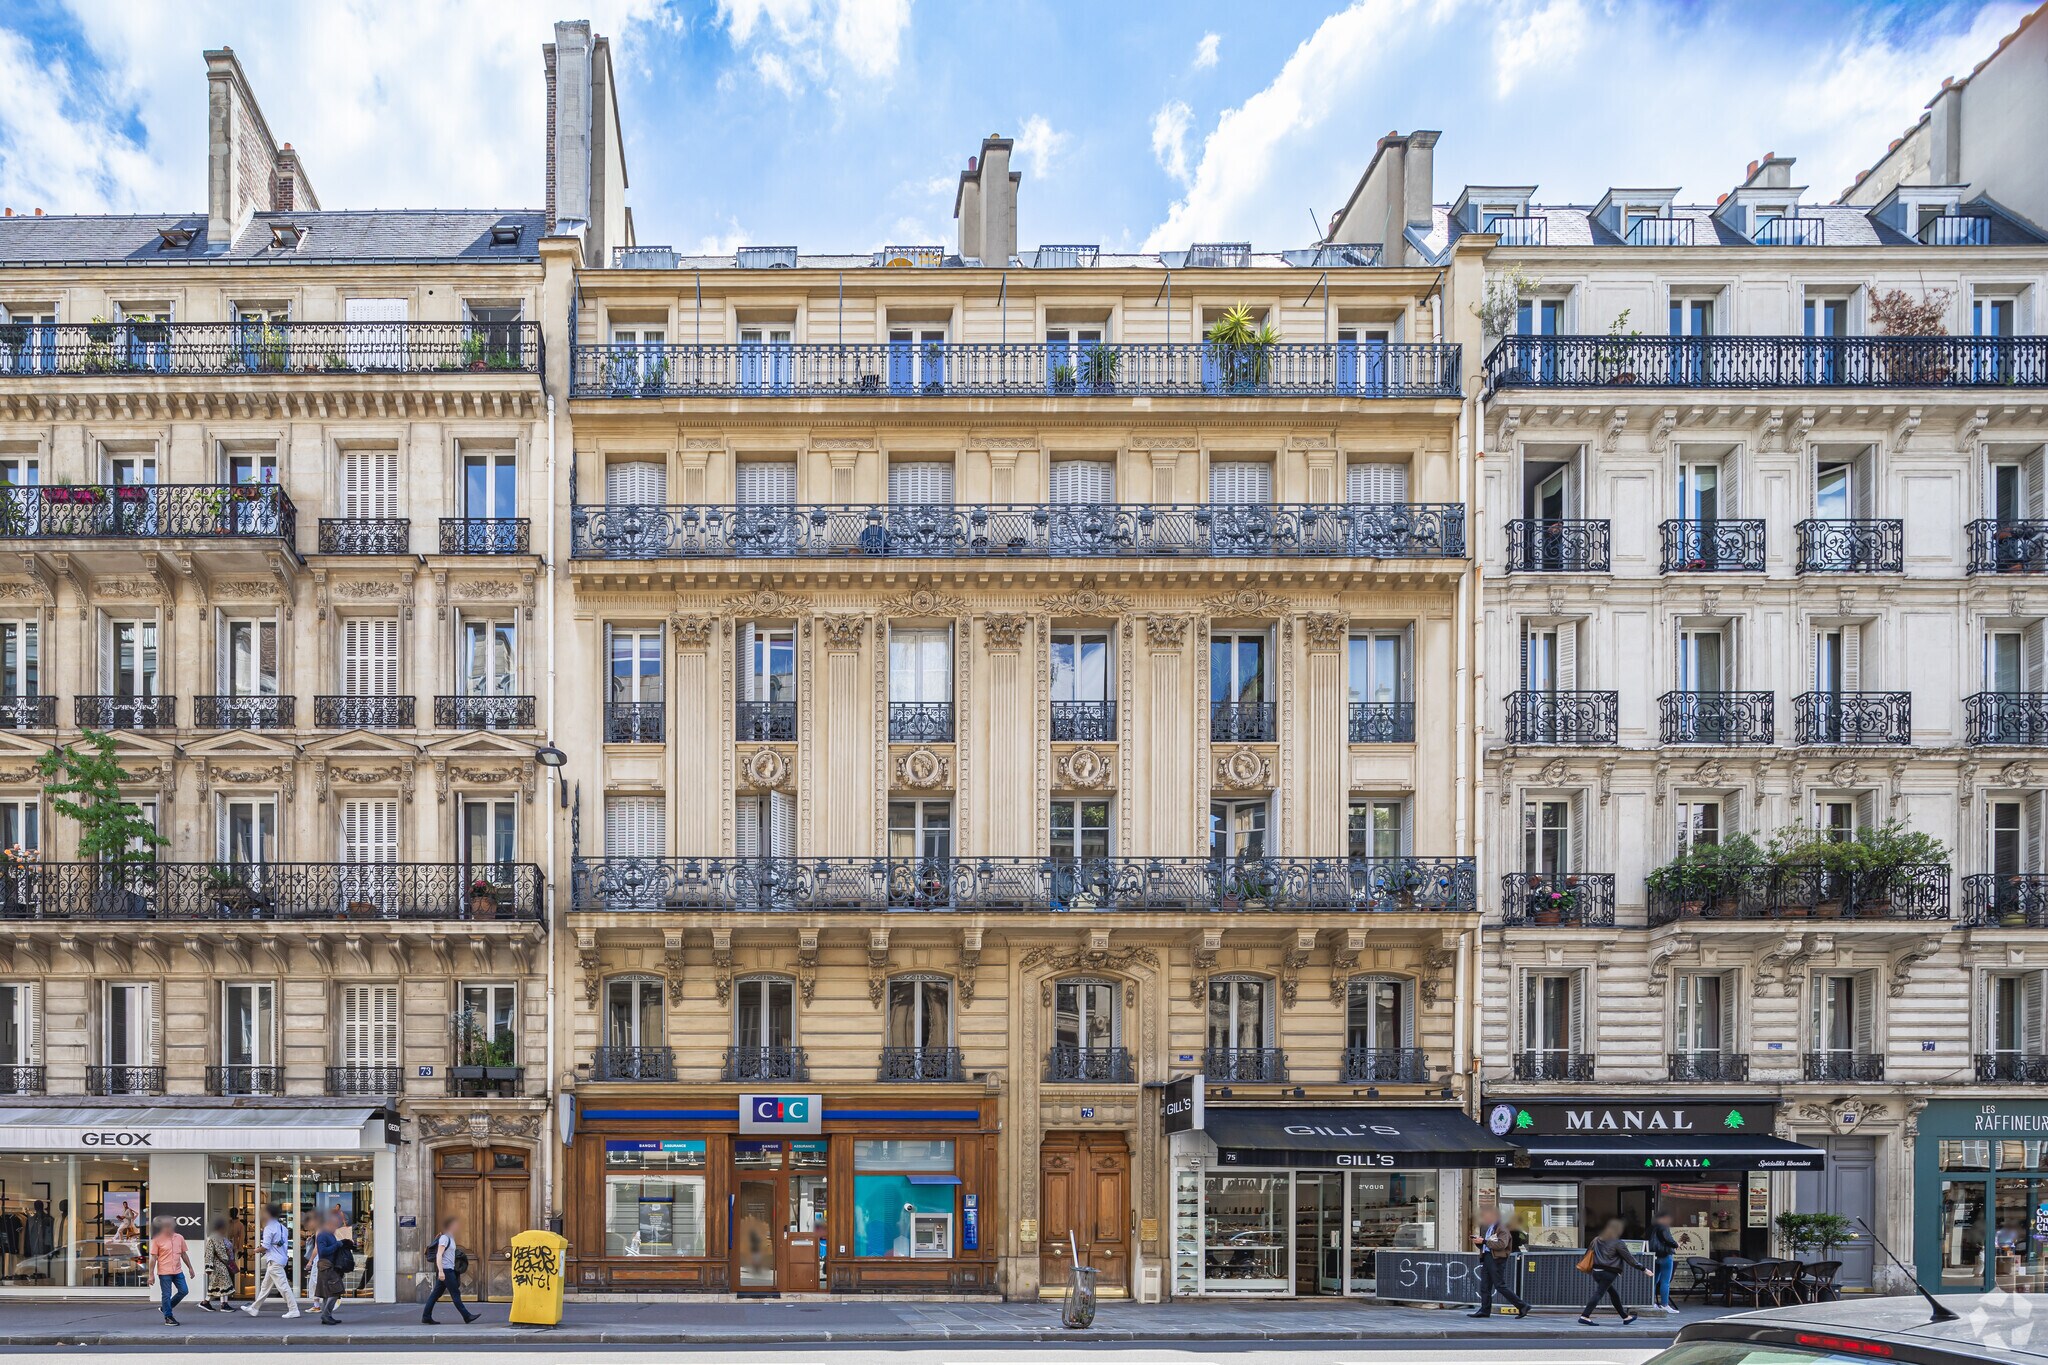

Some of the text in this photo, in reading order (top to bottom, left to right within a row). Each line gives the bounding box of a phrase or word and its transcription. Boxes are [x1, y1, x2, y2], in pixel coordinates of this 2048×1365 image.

[421, 1067, 431, 1075] 73
[758, 1102, 804, 1119] CIC
[1166, 1098, 1191, 1115] GILL'S
[1981, 1105, 1996, 1114] LES
[1083, 1108, 1093, 1118] 75
[1565, 1110, 1693, 1130] MANAL
[387, 1123, 400, 1132] GEOX
[1283, 1124, 1401, 1136] GILL'S
[82, 1132, 152, 1146] GEOX
[1336, 1154, 1395, 1166] GILL'S
[1543, 1159, 1564, 1167] Traiteur
[1654, 1159, 1701, 1167] MANAL
[173, 1216, 202, 1227] OX
